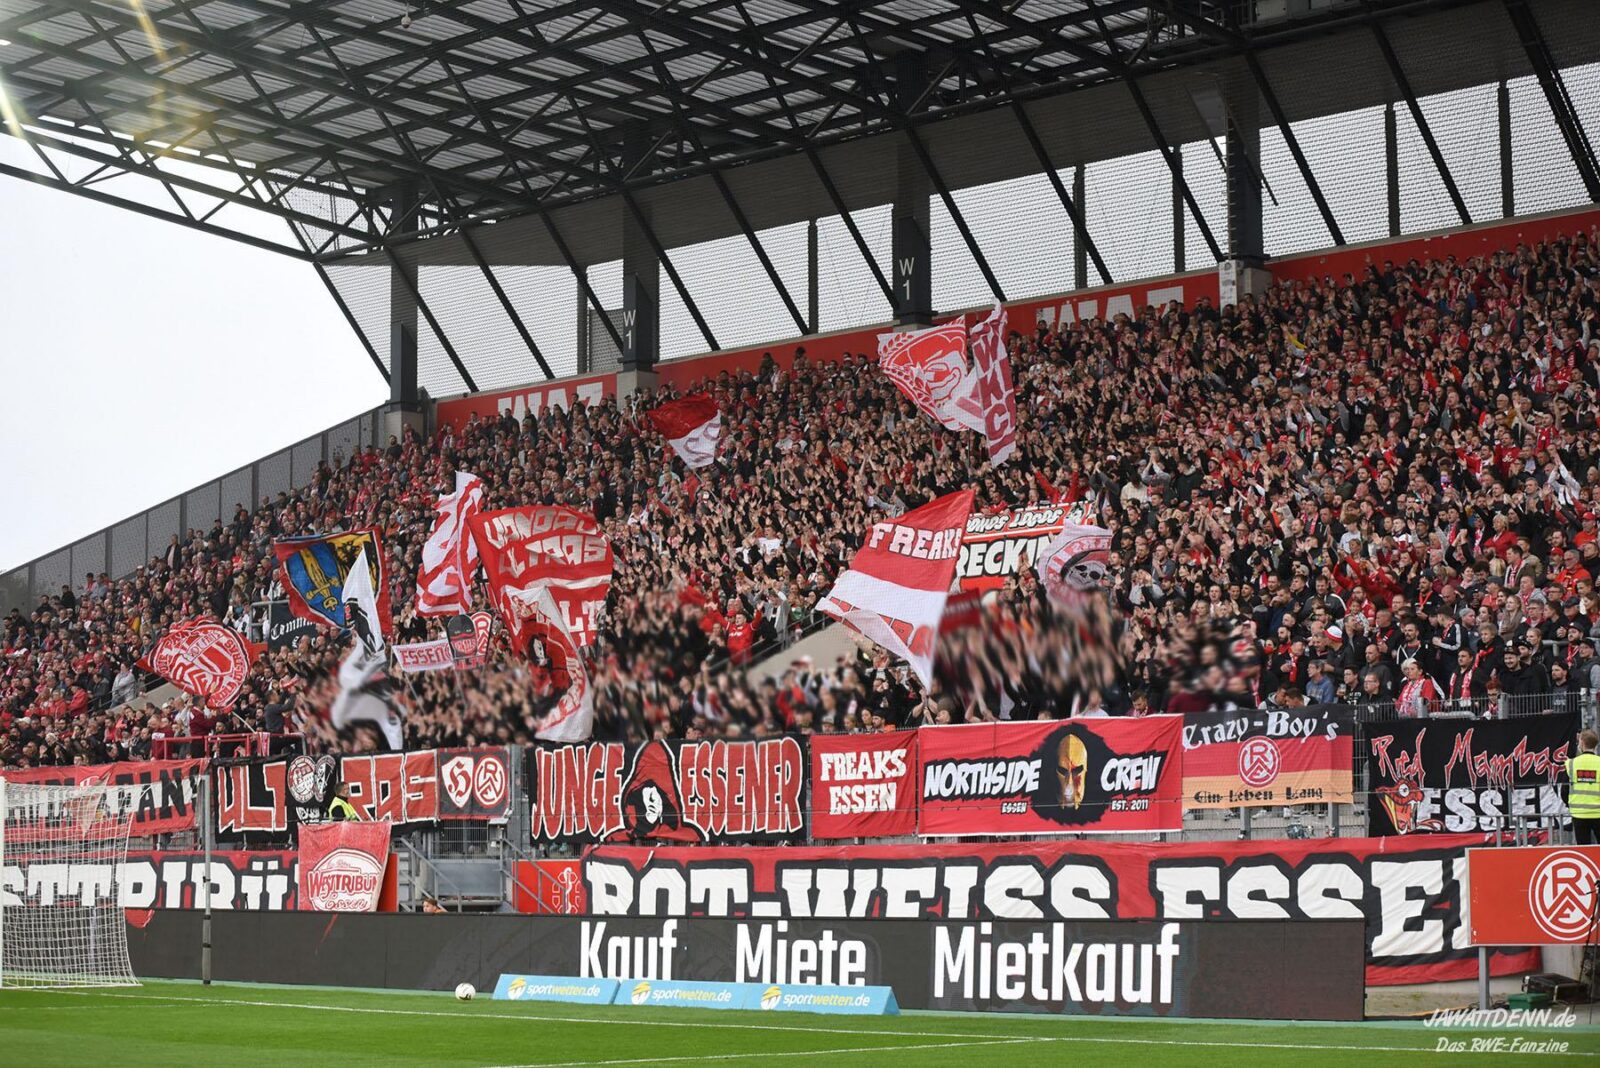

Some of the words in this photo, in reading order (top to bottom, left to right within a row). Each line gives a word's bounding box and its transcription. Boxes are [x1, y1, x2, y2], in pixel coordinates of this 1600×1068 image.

[899, 257, 914, 275] W
[903, 281, 911, 300] 1
[623, 309, 636, 327] W
[626, 333, 633, 349] 1
[820, 749, 907, 782] FREAKS
[1371, 727, 1427, 791] Red
[1444, 727, 1570, 794] Mambas
[924, 759, 1042, 798] NORTHSIDE
[1100, 754, 1162, 793] CREW
[531, 742, 625, 840] JUNGE
[678, 736, 803, 834] ESSENER
[829, 782, 897, 815] ESSEN
[1111, 800, 1129, 811] EST.
[1130, 798, 1149, 811] 2011
[1155, 857, 1469, 958] ESSE
[579, 919, 678, 983] Kauf
[736, 920, 867, 987] Miete
[934, 922, 1180, 1003] Mietkauf
[526, 982, 601, 998] sportwetten.de
[652, 987, 732, 1004] sportwetten.de
[783, 991, 871, 1008] sportwetten.de
